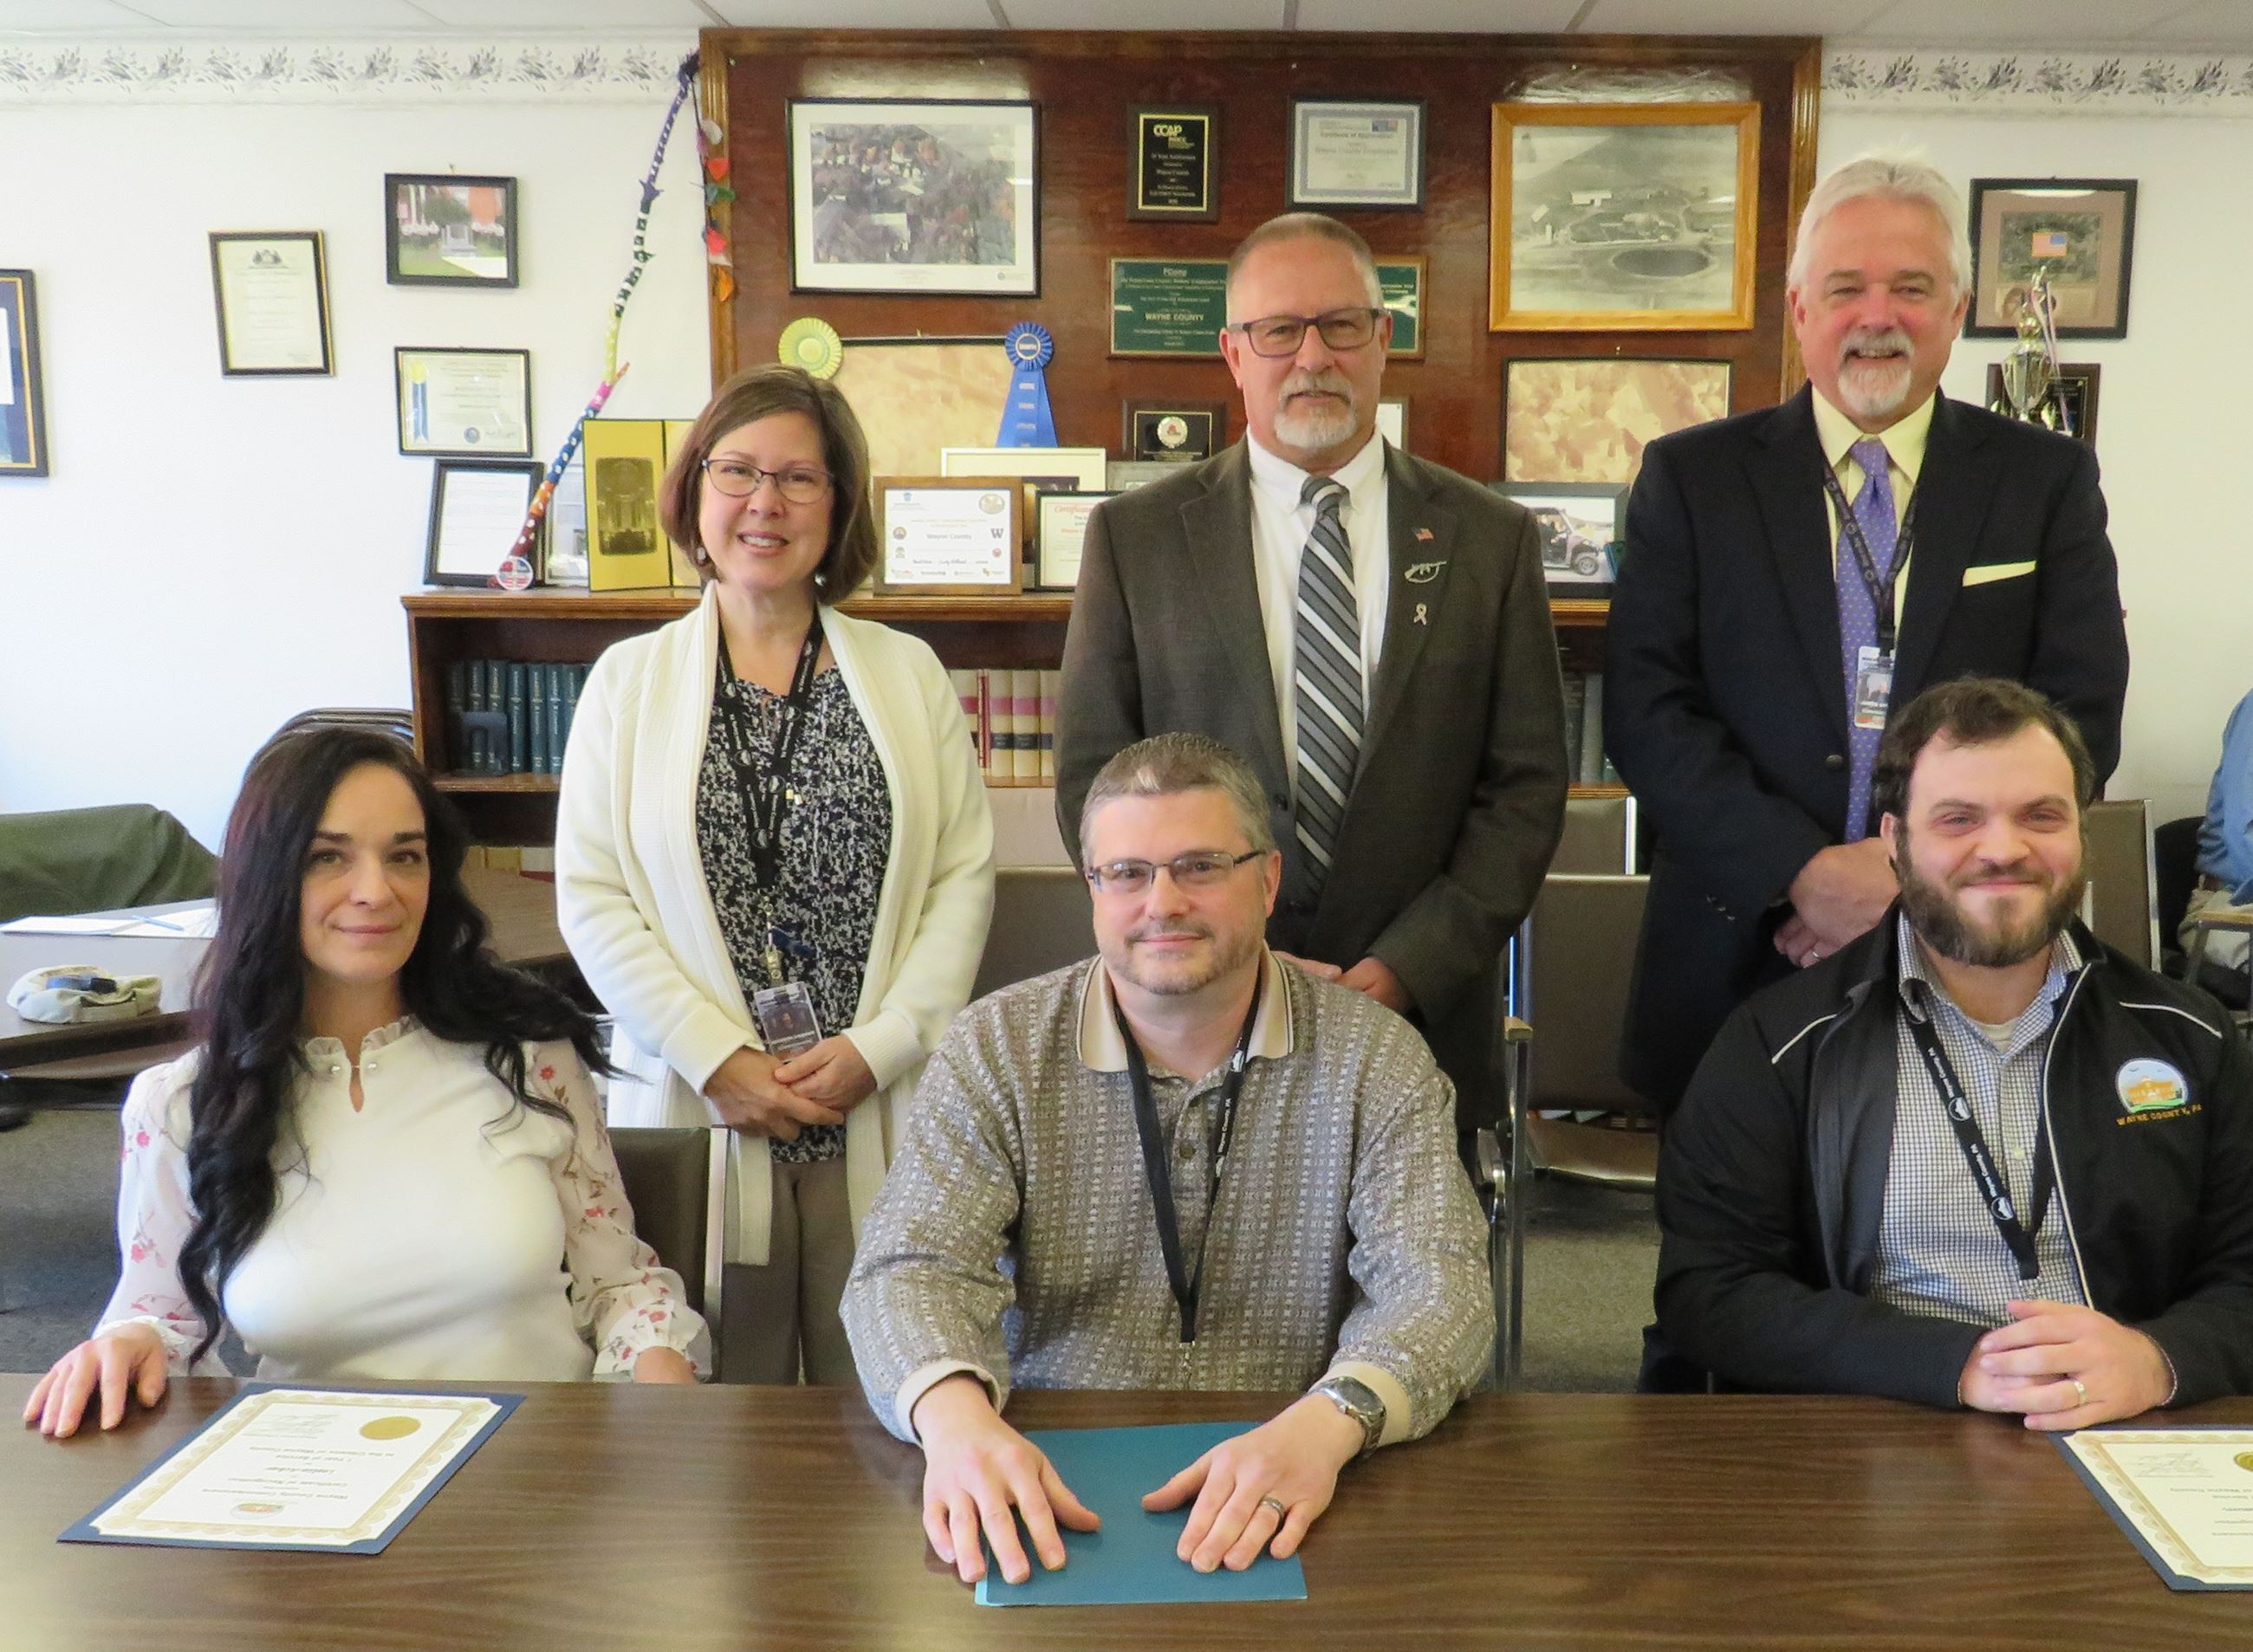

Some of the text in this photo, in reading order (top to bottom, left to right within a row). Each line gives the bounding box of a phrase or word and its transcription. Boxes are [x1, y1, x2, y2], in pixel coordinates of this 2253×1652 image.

[1153, 124, 1183, 137] CCAP
[1145, 313, 1204, 321] WAYNE COUNTY
[990, 528, 1004, 539] W
